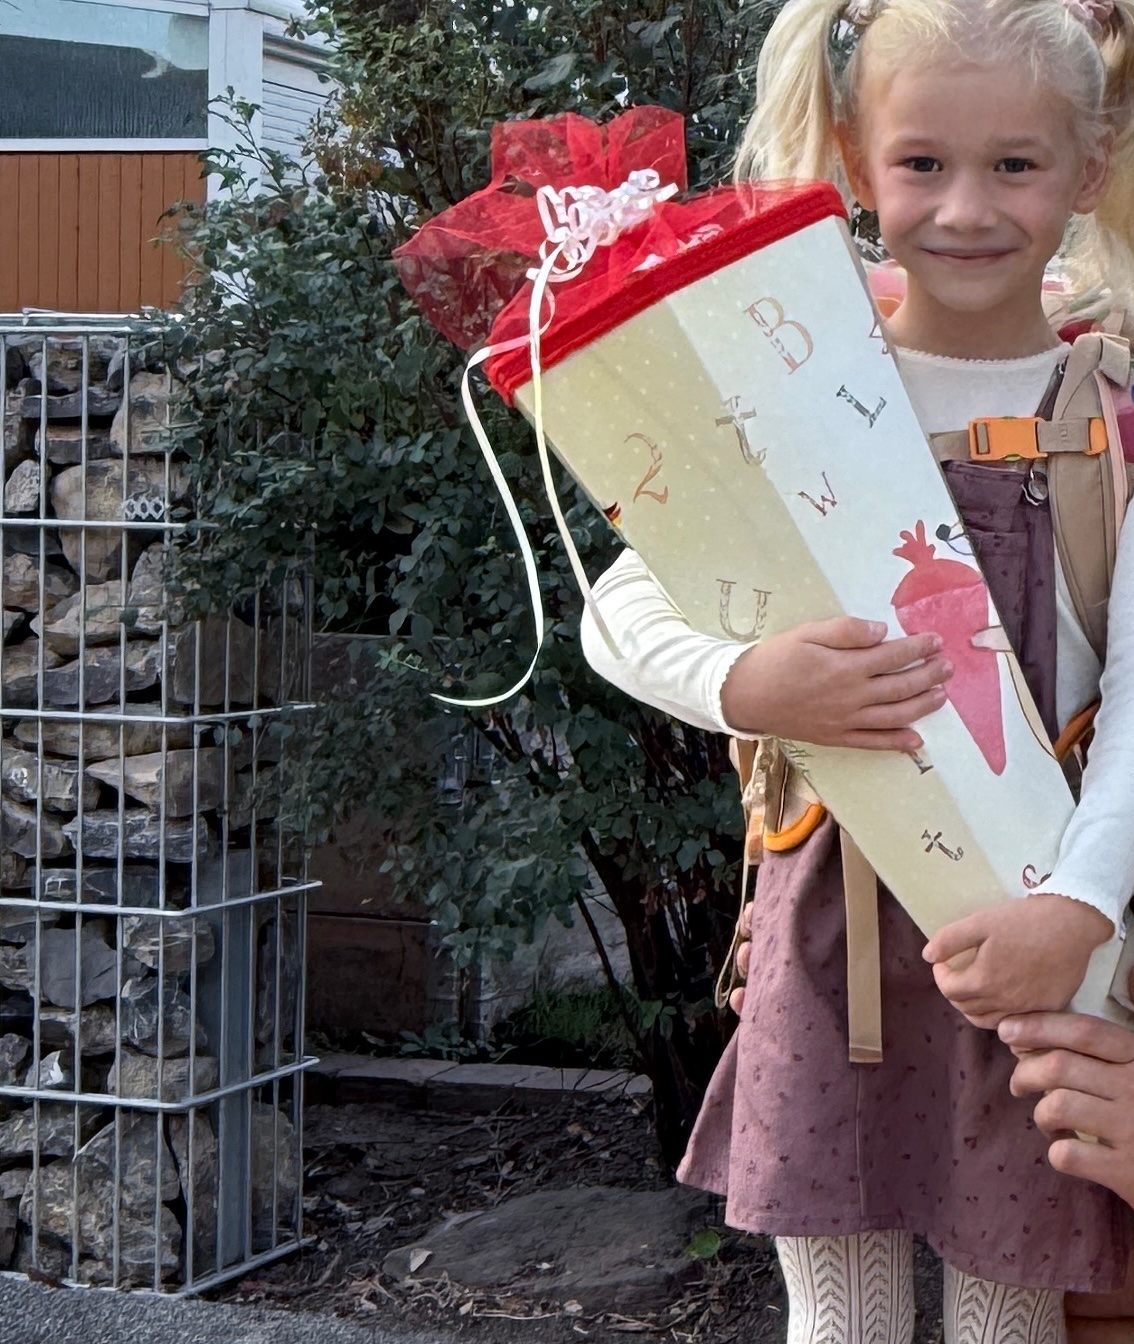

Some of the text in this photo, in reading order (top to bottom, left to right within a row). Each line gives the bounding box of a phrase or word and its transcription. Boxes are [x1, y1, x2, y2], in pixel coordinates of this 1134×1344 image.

[744, 296, 814, 375] B
[836, 384, 887, 429] L
[624, 432, 669, 505] 2
